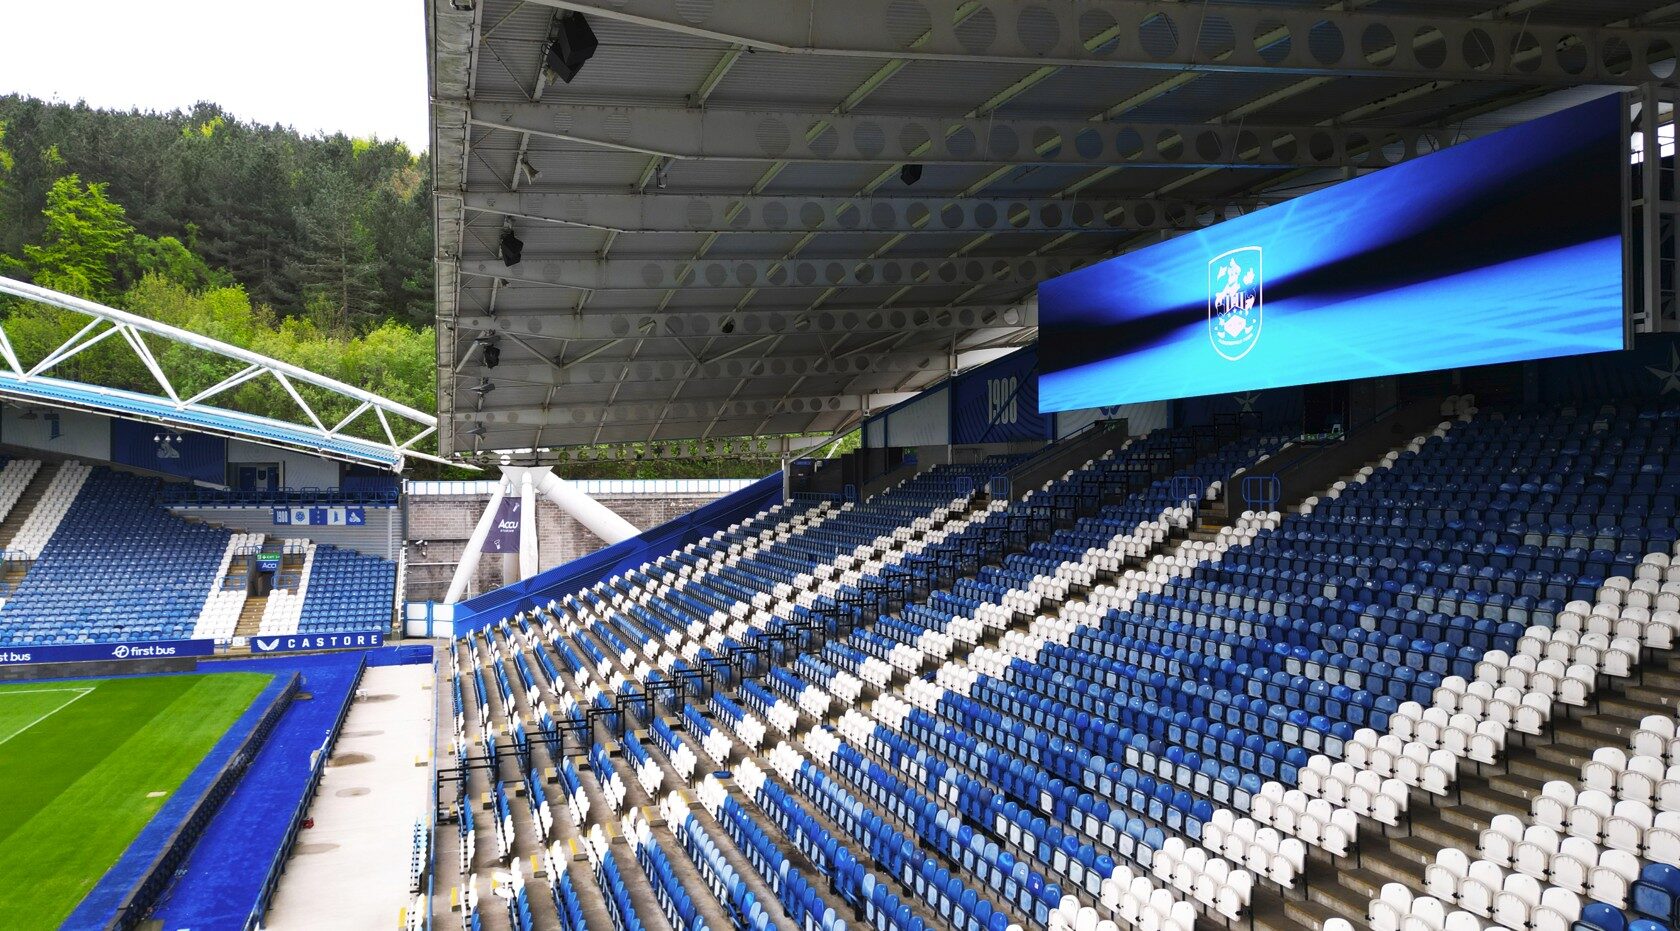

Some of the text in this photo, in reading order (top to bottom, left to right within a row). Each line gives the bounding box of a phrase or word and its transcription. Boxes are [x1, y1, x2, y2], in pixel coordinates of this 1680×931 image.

[987, 376, 1018, 425] 1908
[498, 519, 519, 529] Accu
[287, 634, 378, 649] CASTORE
[130, 645, 176, 656] first bus
[10, 651, 31, 662] bus
